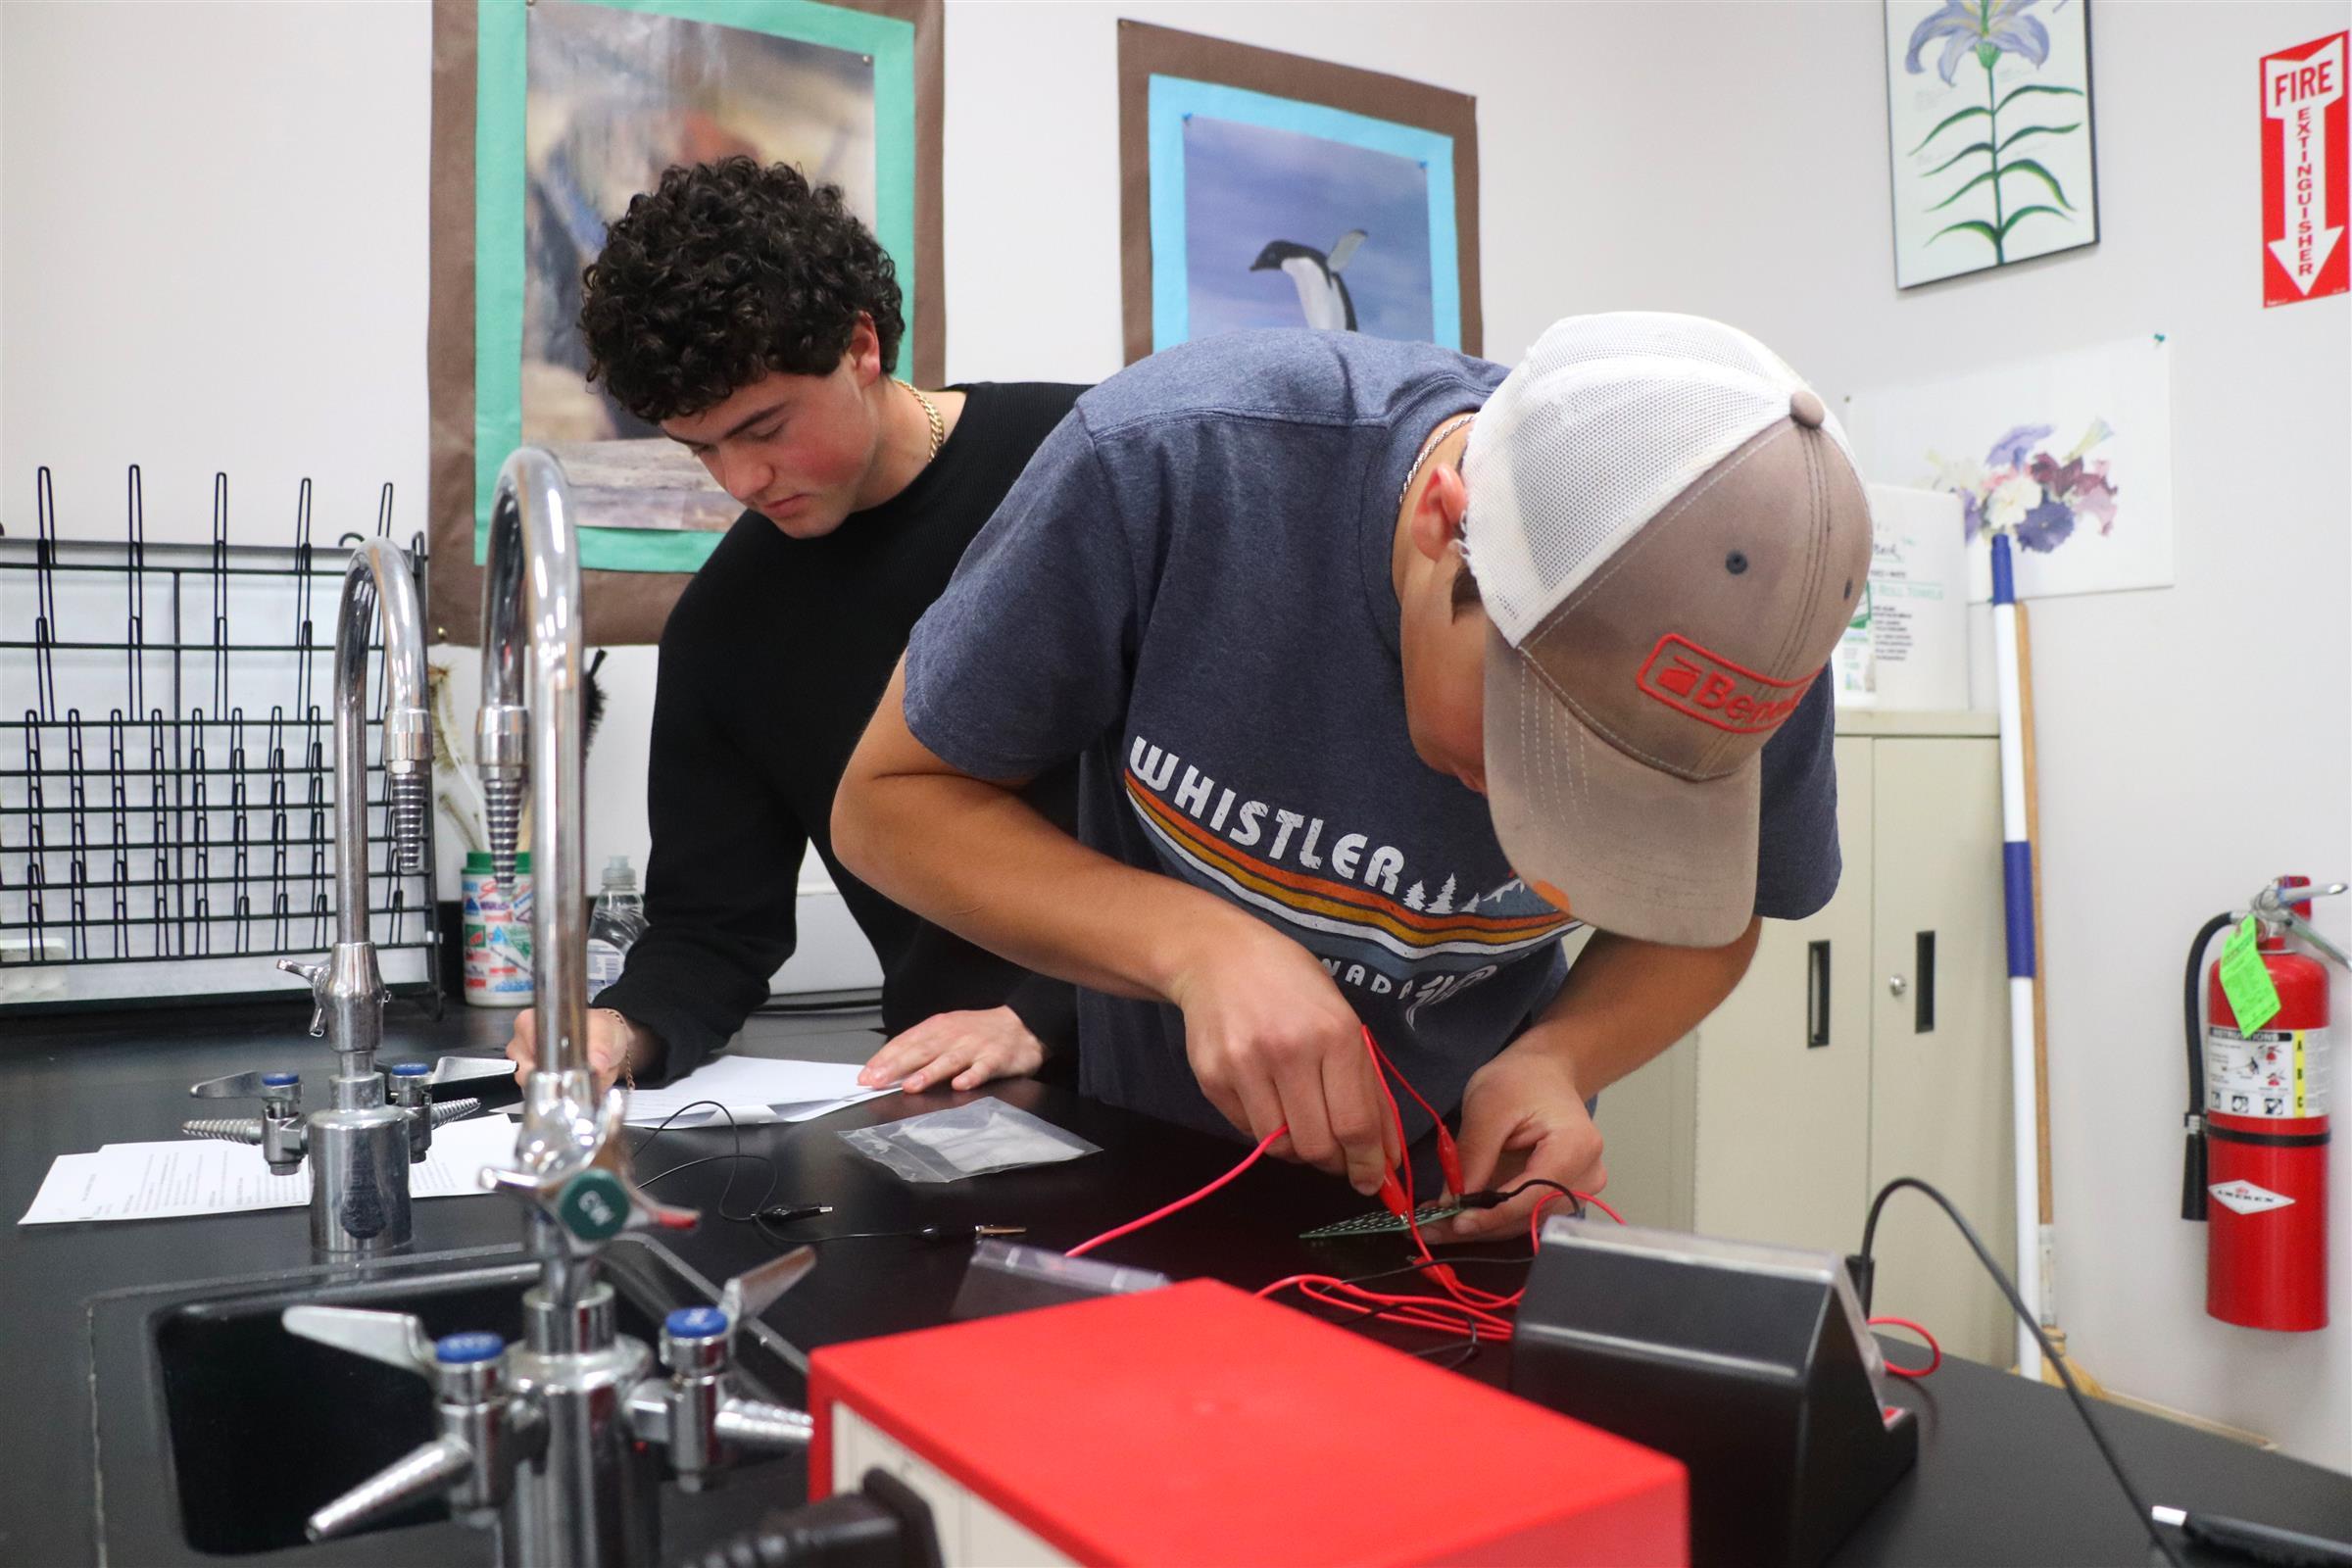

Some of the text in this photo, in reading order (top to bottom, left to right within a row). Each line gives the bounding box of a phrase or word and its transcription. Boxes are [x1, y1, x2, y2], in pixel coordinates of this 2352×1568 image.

[2275, 60, 2333, 107] FIRE
[2297, 108, 2313, 275] EXTINGUISHER
[1129, 735, 1405, 896] WHISTLER
